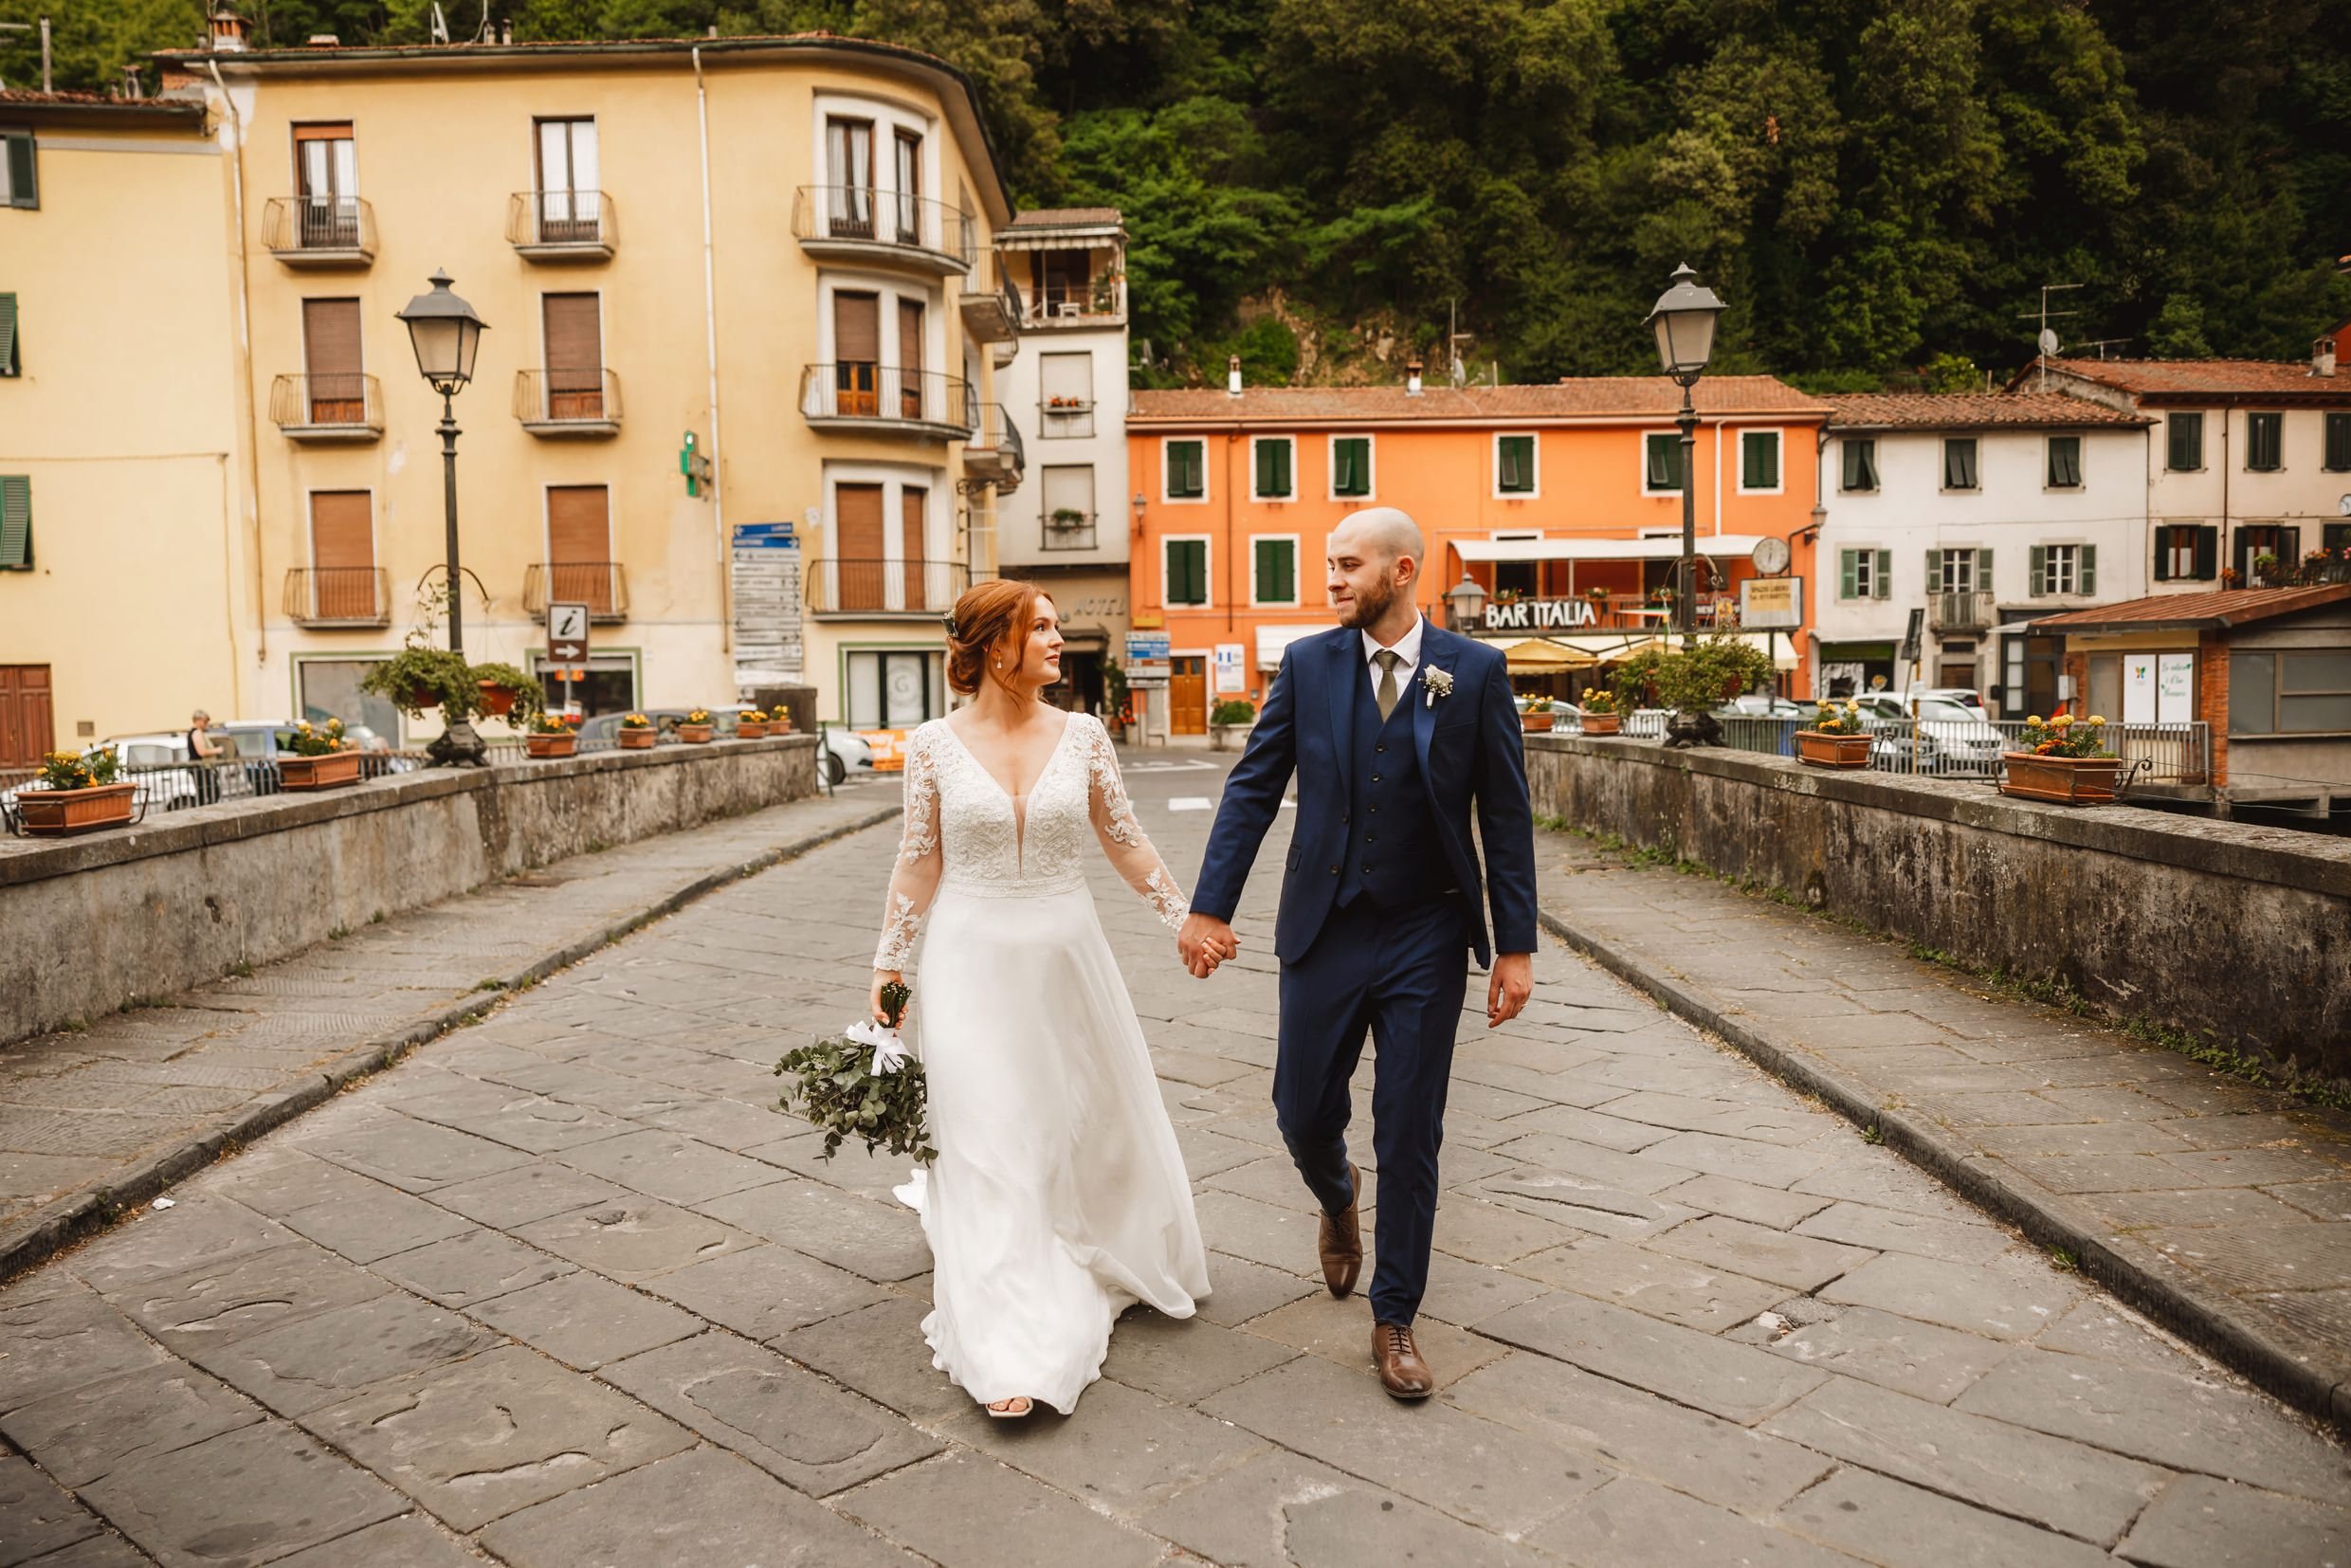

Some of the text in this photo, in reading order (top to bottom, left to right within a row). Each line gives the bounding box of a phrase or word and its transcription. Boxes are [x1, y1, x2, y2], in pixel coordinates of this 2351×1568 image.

[1074, 598, 1124, 615] HOTEL
[1485, 600, 1596, 628] BAR ITALIA
